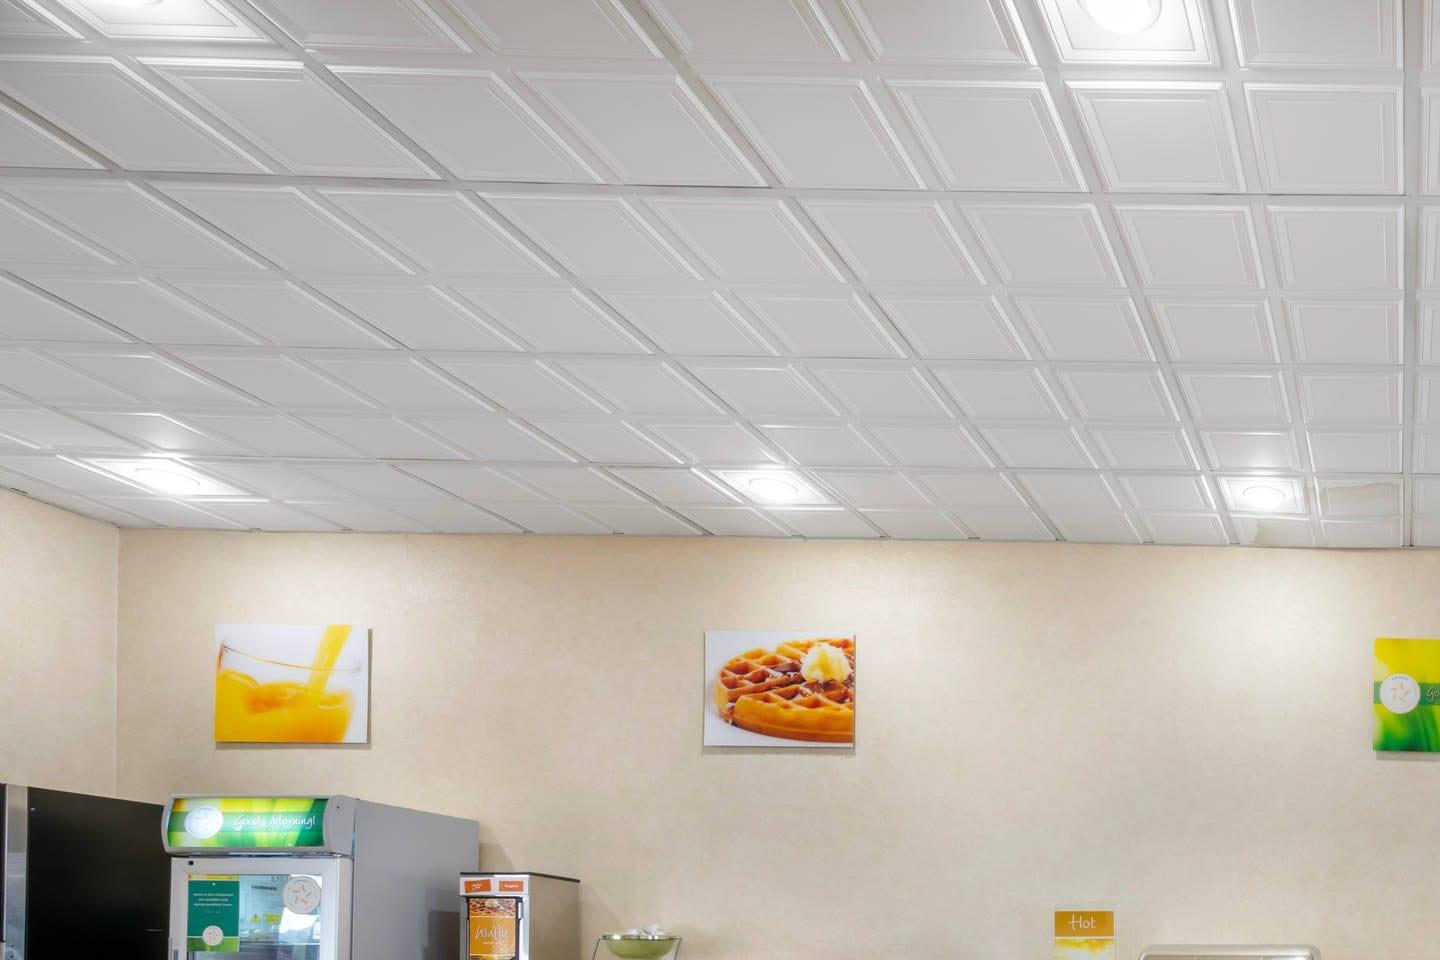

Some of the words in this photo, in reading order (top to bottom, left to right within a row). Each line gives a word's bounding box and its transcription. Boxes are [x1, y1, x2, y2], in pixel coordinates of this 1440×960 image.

[233, 815, 261, 831] Good
[262, 815, 316, 830] Morning!
[1068, 913, 1097, 931] Hot
